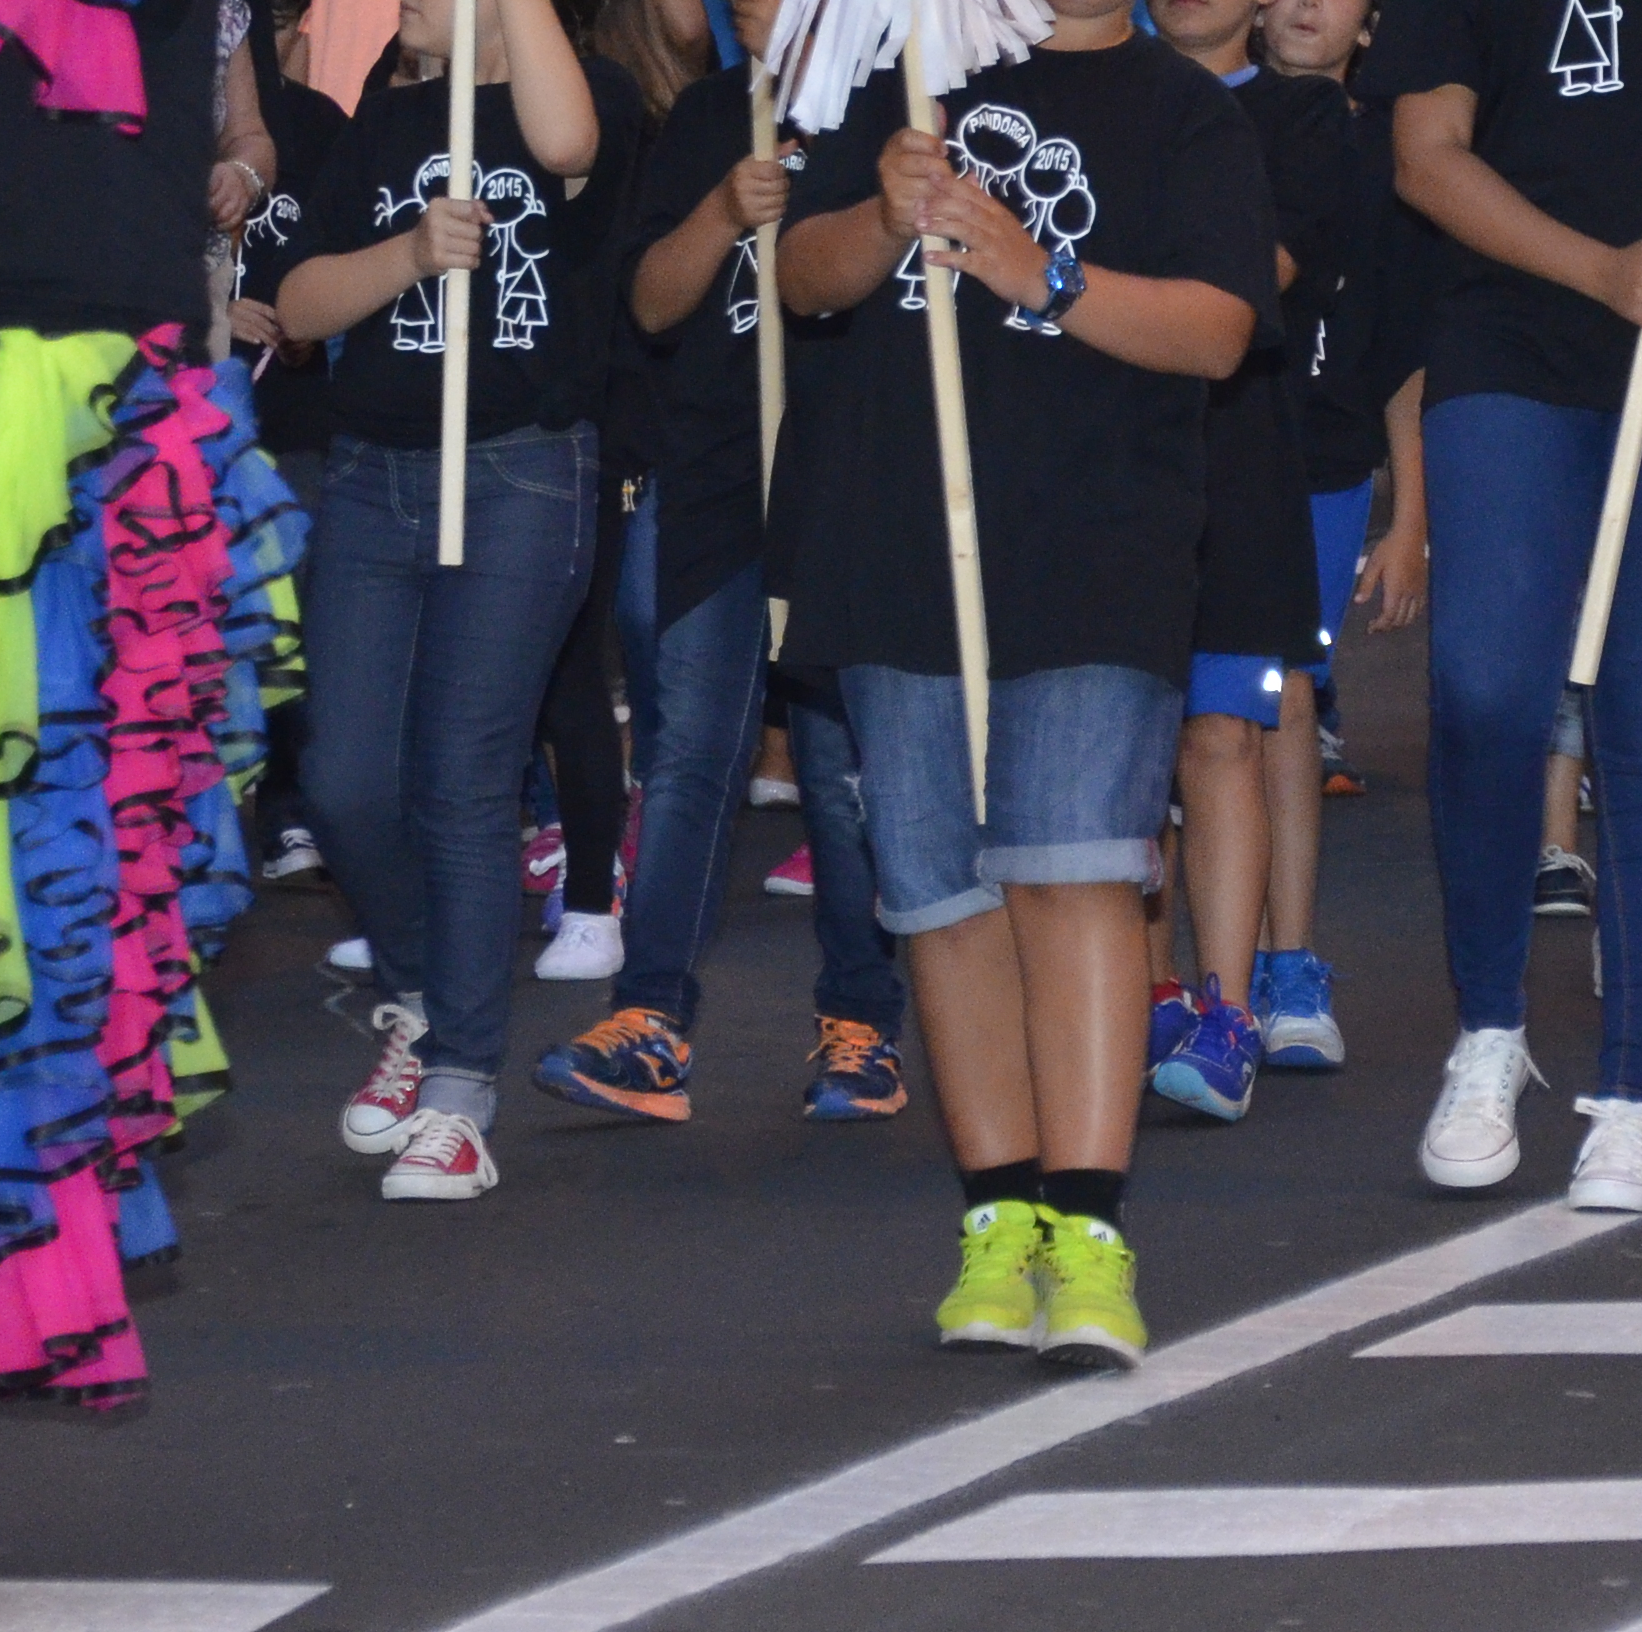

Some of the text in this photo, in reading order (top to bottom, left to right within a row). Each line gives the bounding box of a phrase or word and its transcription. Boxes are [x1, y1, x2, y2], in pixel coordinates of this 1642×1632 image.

[969, 111, 1032, 149] PANDORGA
[1034, 146, 1073, 171] 2015
[487, 176, 523, 200] 2015
